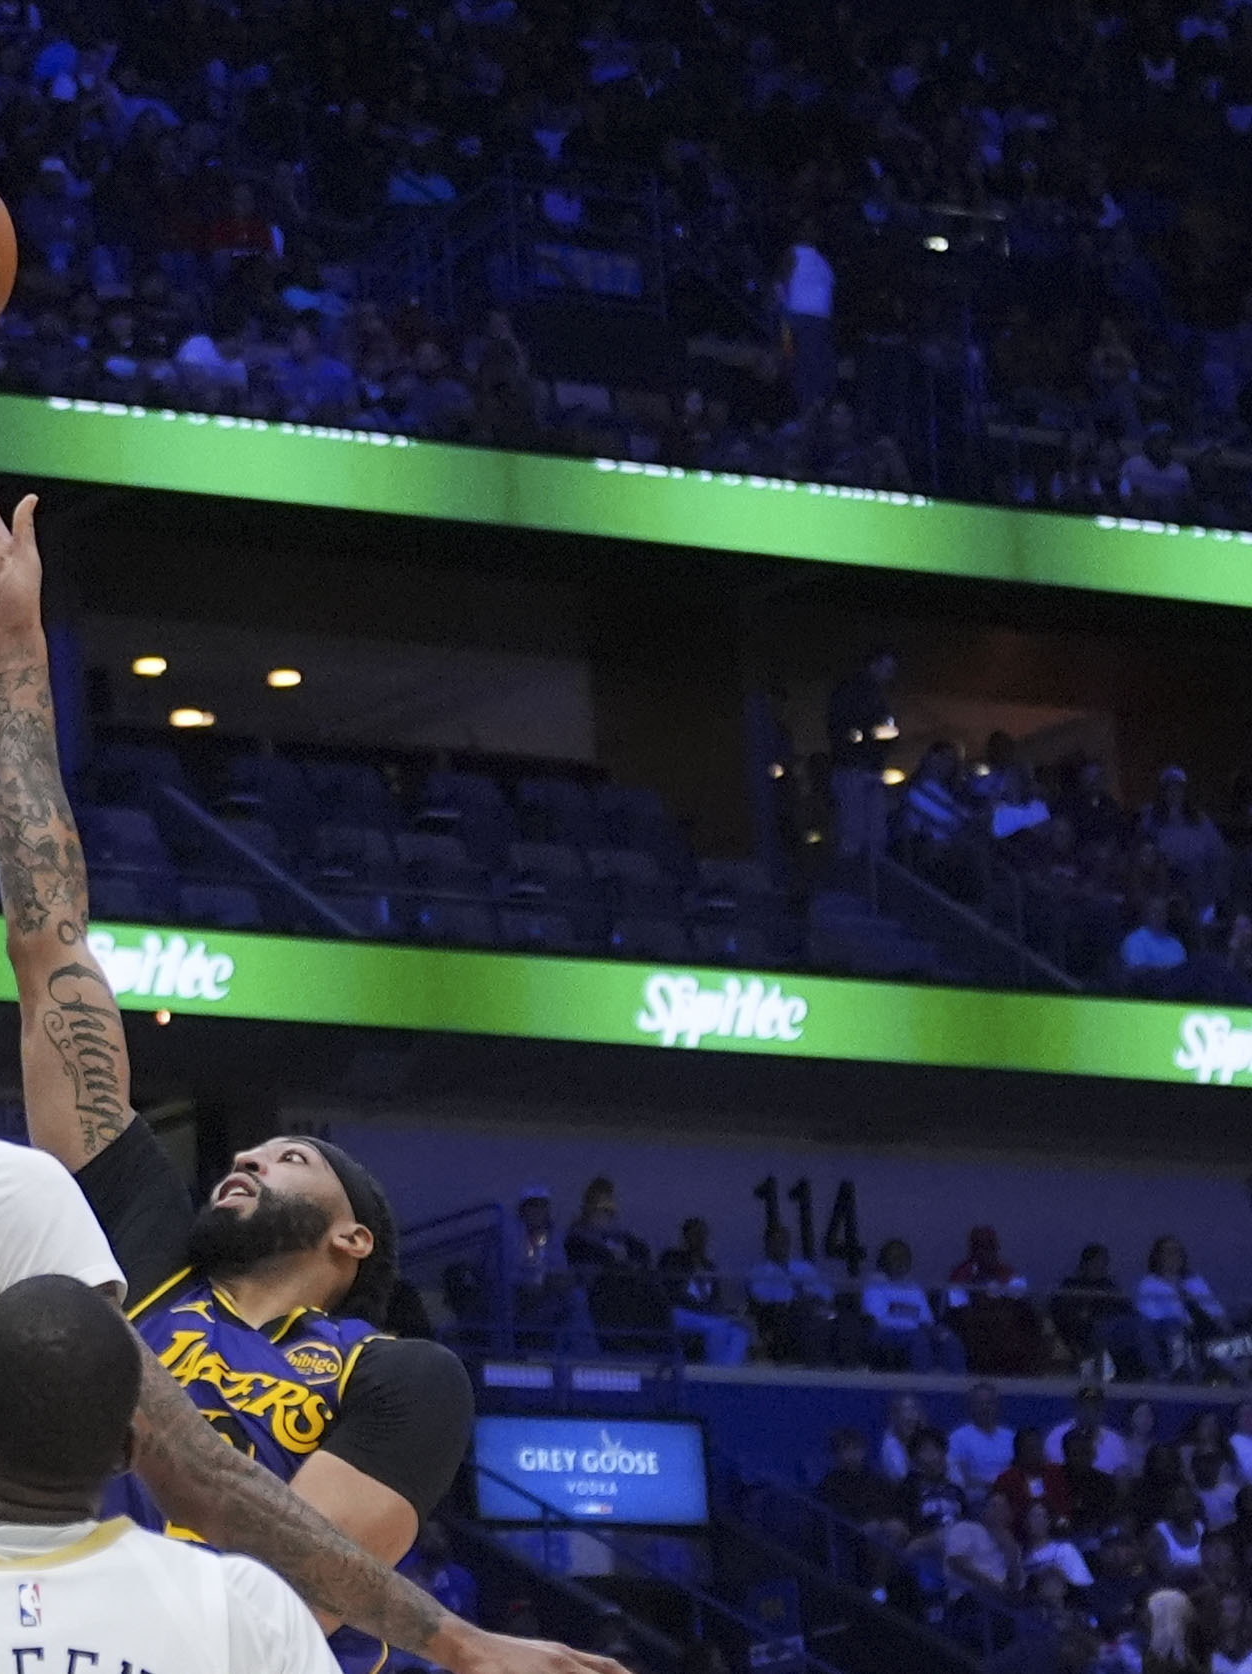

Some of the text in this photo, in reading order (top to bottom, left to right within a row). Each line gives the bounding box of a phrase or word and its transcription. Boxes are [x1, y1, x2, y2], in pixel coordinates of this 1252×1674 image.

[89, 932, 235, 1000] prite
[636, 974, 808, 1049] Sprite
[753, 1176, 866, 1277] 114
[517, 1449, 659, 1475] GREY GOOSE
